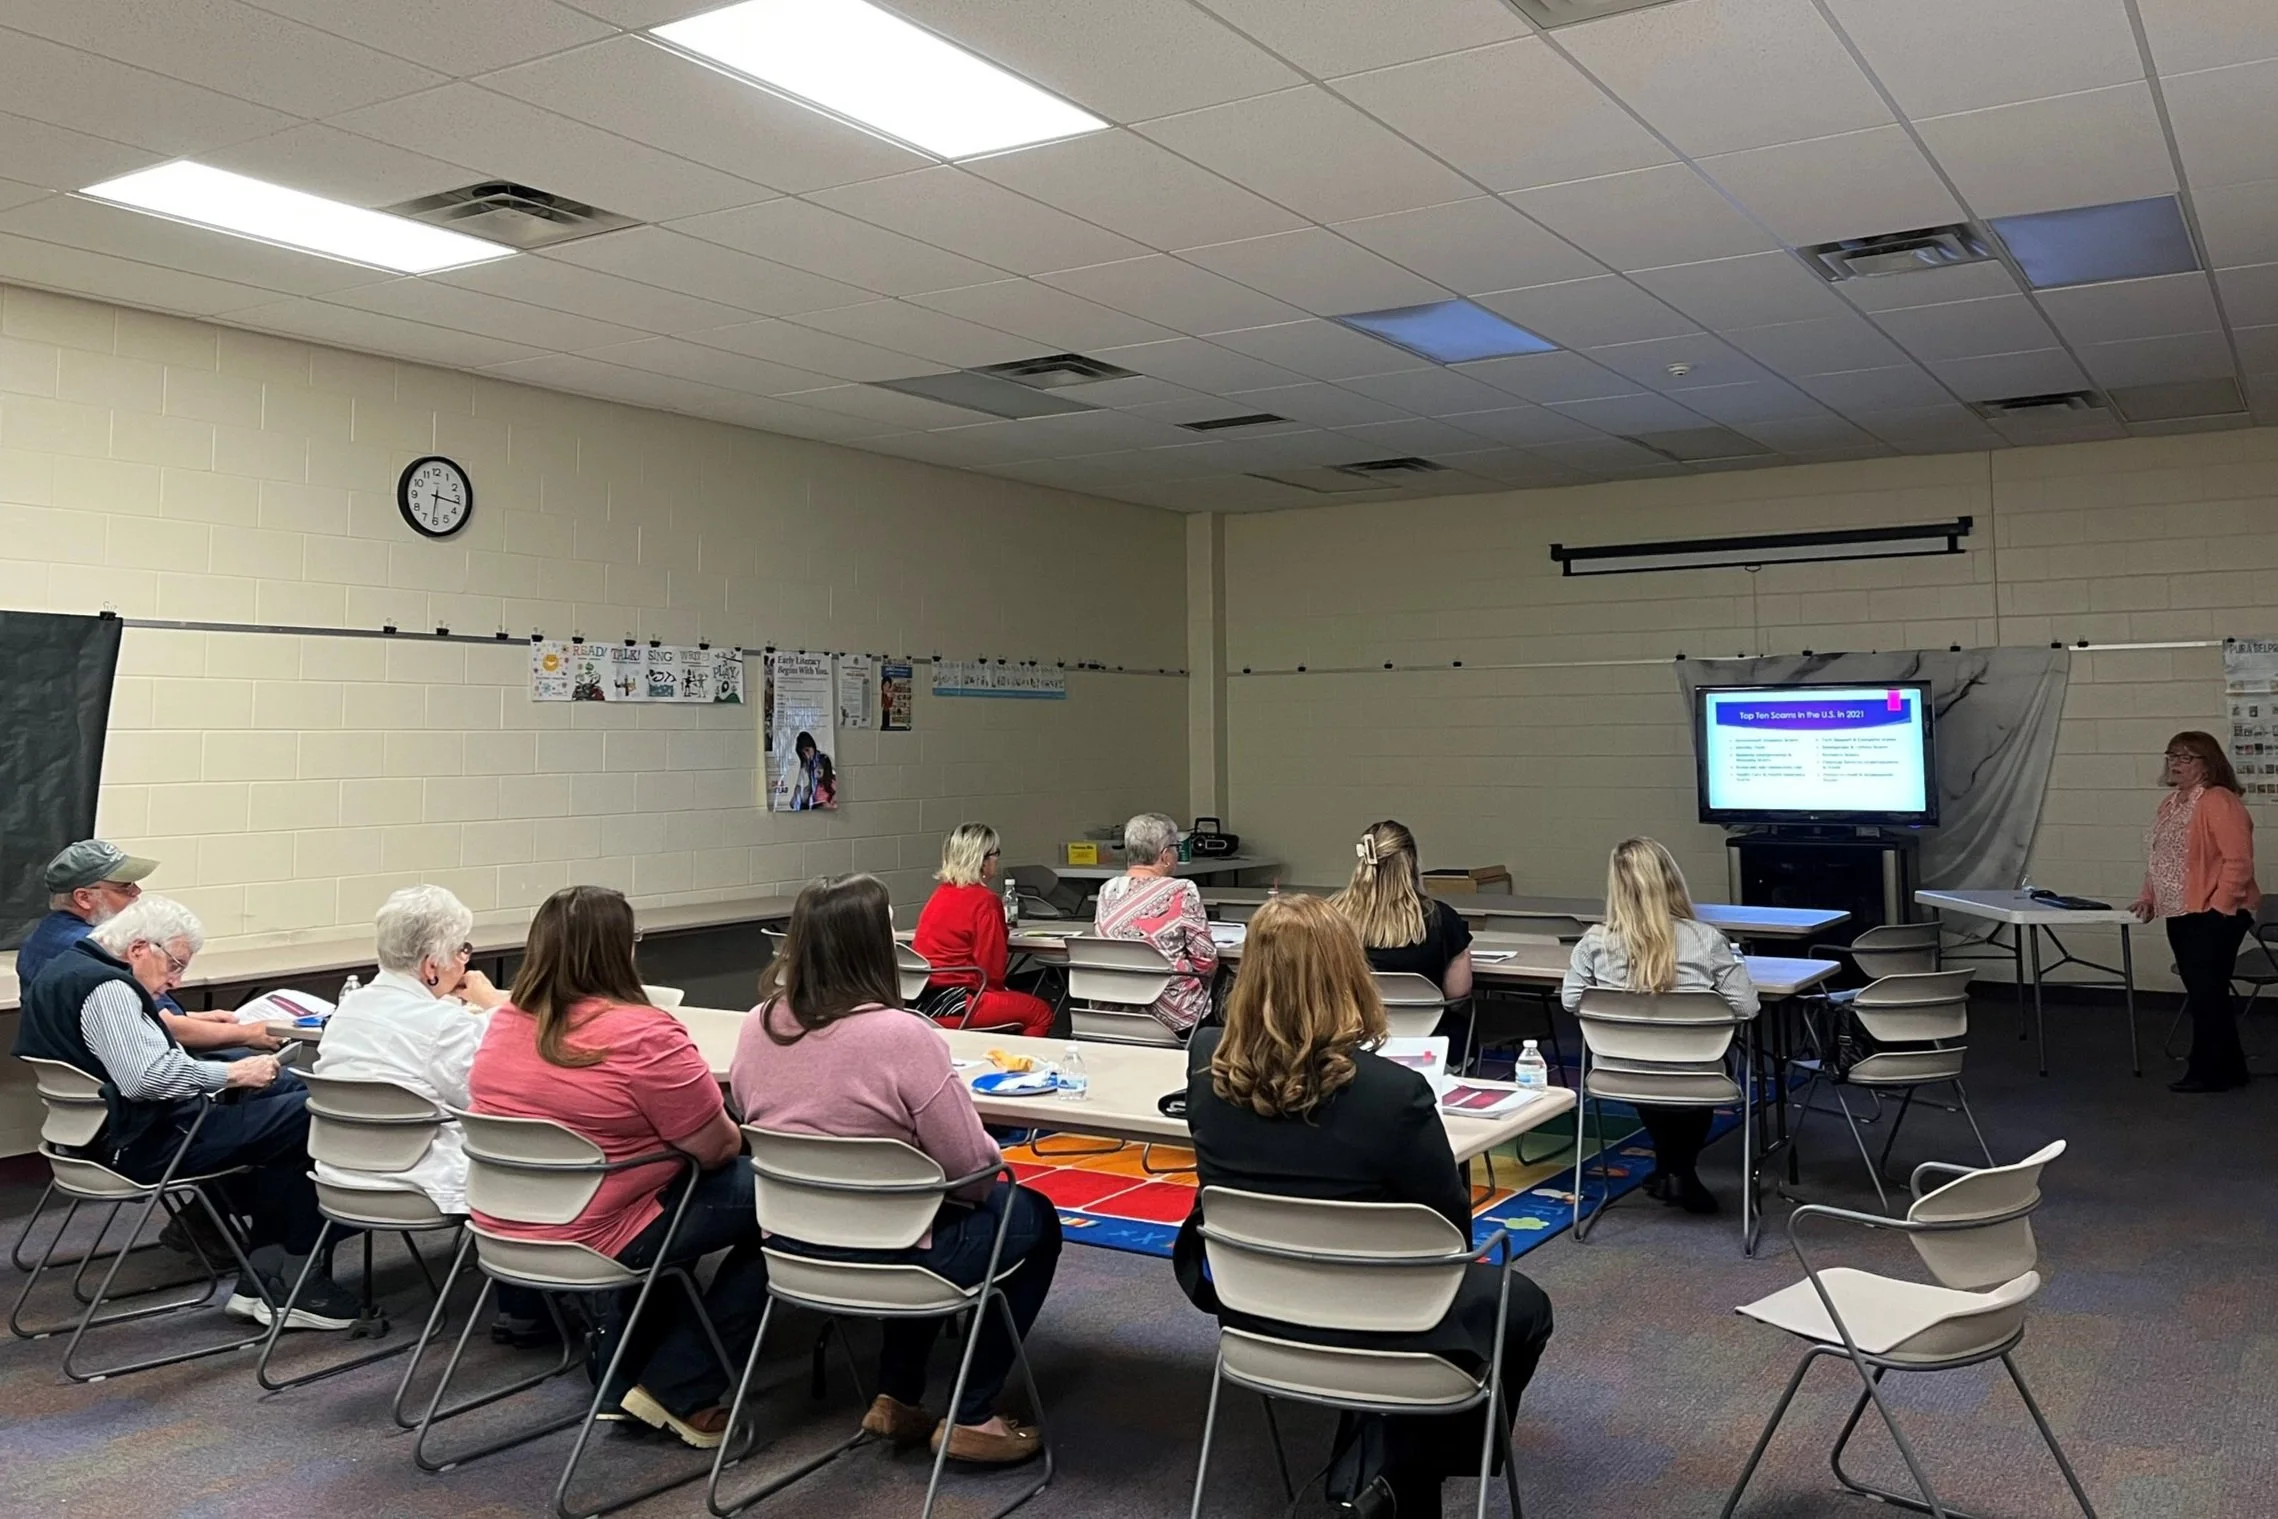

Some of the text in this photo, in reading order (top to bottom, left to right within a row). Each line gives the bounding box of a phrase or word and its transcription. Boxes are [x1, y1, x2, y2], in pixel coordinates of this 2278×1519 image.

[423, 471, 430, 479] 11
[432, 468, 441, 477] 12
[414, 479, 424, 488] 10
[451, 483, 458, 492] 2
[411, 490, 418, 498] 9
[413, 503, 421, 511] 8
[451, 507, 457, 515] 4
[422, 513, 428, 521] 7
[432, 516, 439, 526] 6
[442, 514, 450, 523] 5
[777, 656, 821, 669] Early Literacy
[1739, 712, 1754, 721] Top
[1755, 712, 1770, 720] Ten
[1771, 711, 1796, 720] Scams
[1807, 711, 1821, 719] the
[1822, 710, 1835, 719] U.S.
[1837, 710, 1845, 718] in
[1846, 710, 1864, 719] 2021
